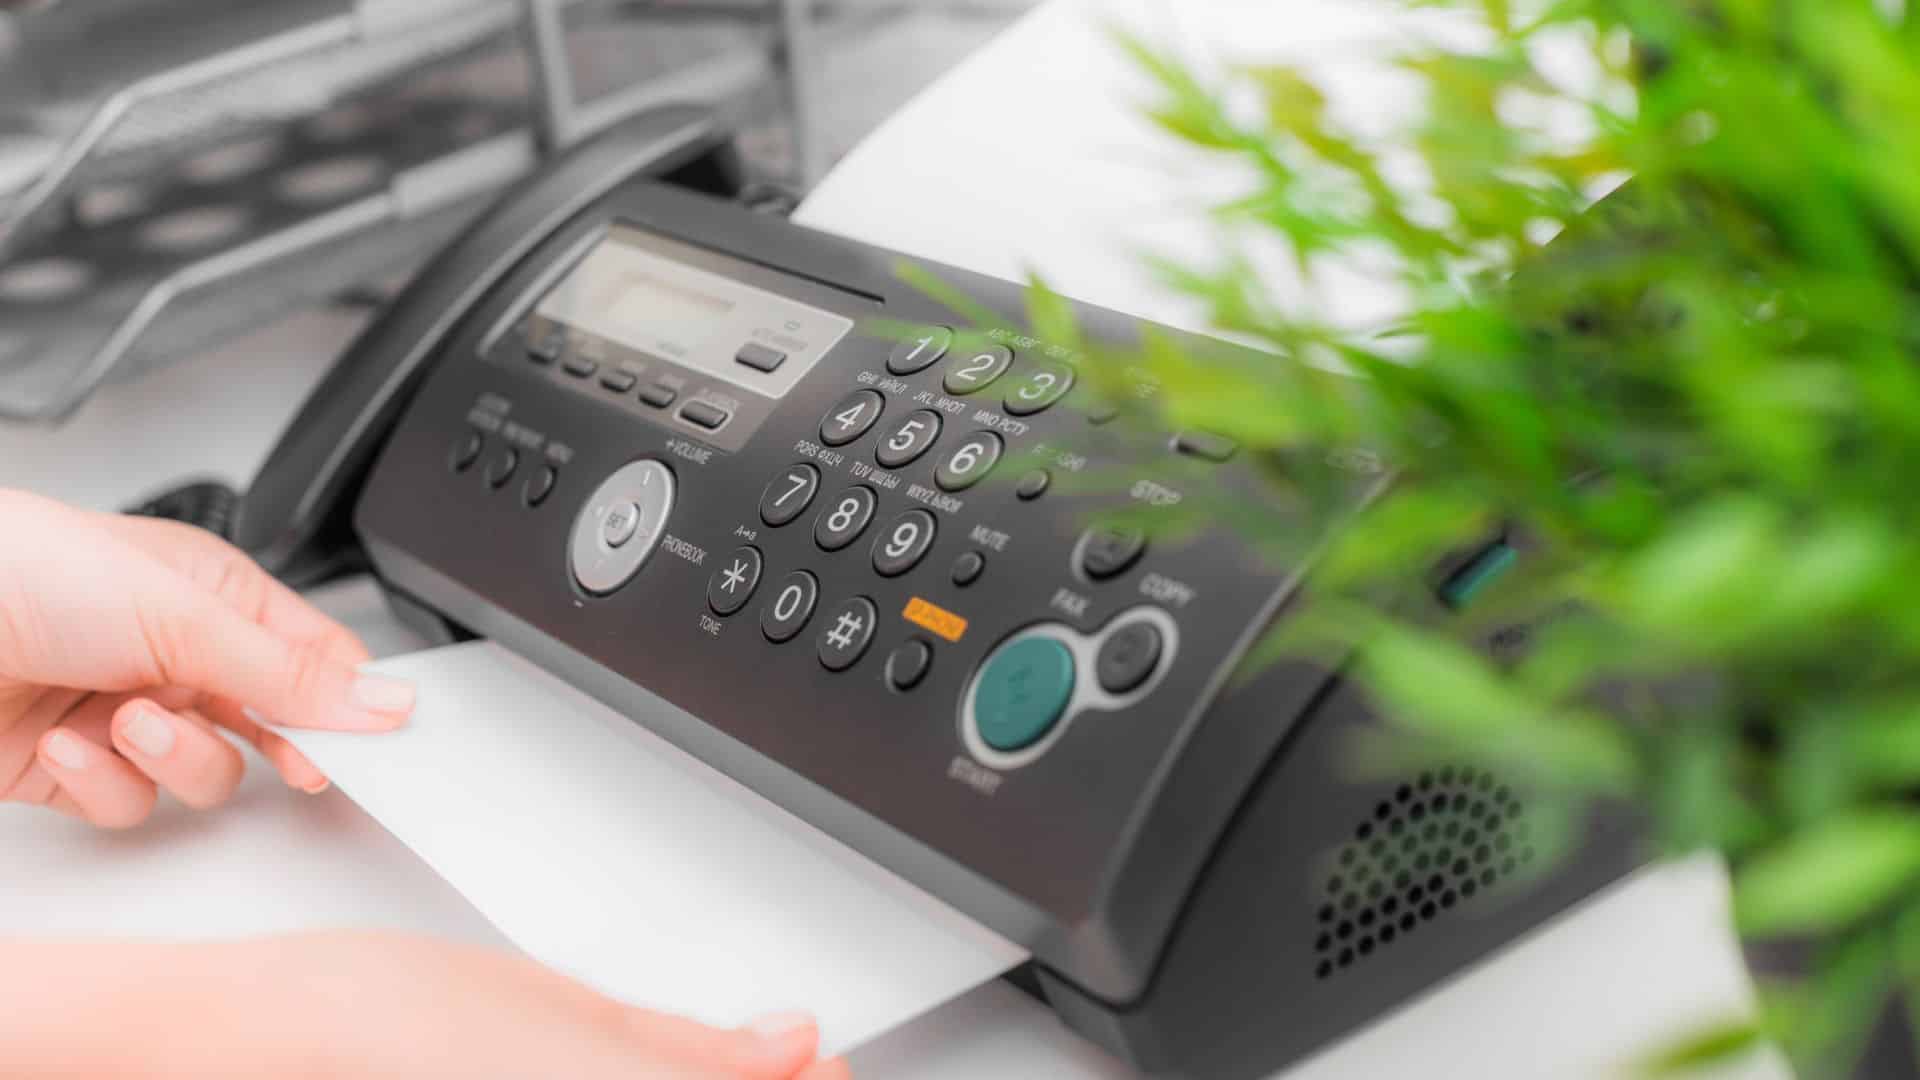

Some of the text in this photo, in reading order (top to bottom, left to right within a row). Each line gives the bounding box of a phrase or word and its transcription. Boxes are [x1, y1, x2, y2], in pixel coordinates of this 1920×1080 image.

[906, 336, 934, 361] 1
[956, 354, 994, 381] 2
[913, 391, 932, 405] JKL
[1018, 373, 1056, 399] 3
[835, 402, 866, 430] 4
[889, 420, 924, 450] 5
[850, 461, 872, 477] TUV
[949, 442, 984, 474] 6
[774, 474, 808, 507] 7
[1130, 480, 1183, 505] STOP
[606, 513, 628, 529] SET
[828, 498, 859, 532] 8
[660, 534, 707, 566] PHONEBOOK
[885, 522, 919, 557] 9
[969, 524, 1011, 551] MUTE
[774, 585, 802, 621] 0
[1051, 587, 1090, 617] FAX
[1139, 573, 1196, 607] COPY
[700, 615, 722, 635] TONE
[826, 611, 862, 649] #
